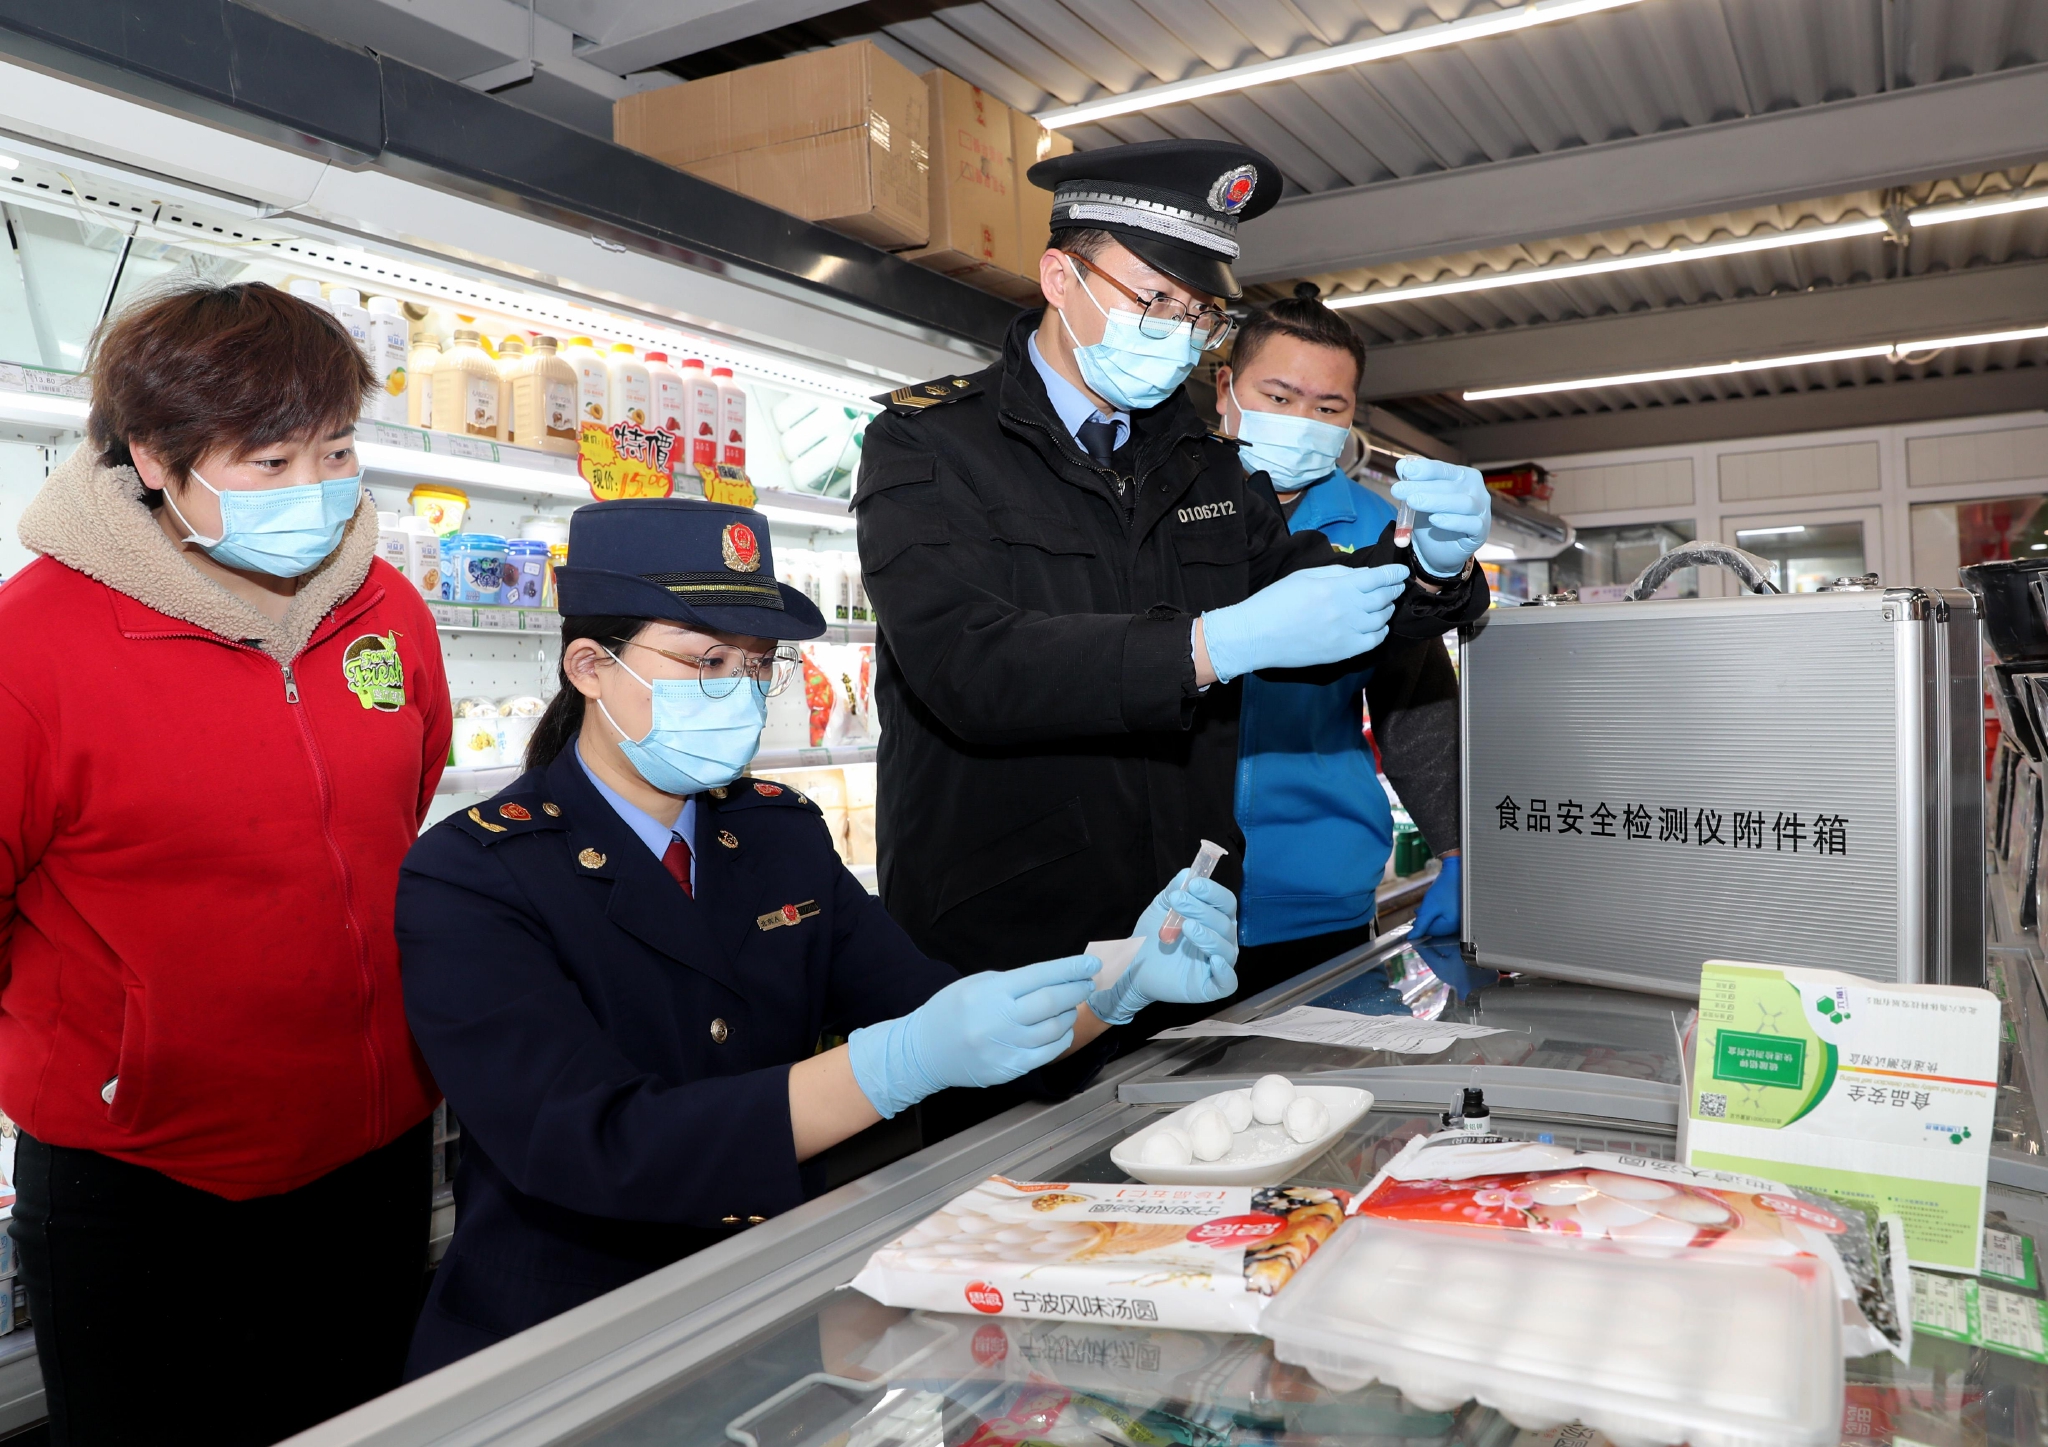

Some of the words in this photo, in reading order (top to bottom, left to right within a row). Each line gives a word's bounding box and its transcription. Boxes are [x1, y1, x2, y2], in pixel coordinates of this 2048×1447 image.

[614, 425, 674, 473] 特價
[1177, 500, 1237, 523] 0106212
[1495, 795, 1850, 856] 食品安全检测仪附件箱
[1849, 1053, 1938, 1074] 快速检测试剂盒
[1847, 1084, 1931, 1111] 食品安全
[1618, 1155, 1776, 1193] 地道大汤圆
[1013, 1290, 1158, 1322] 宁波风味汤圆
